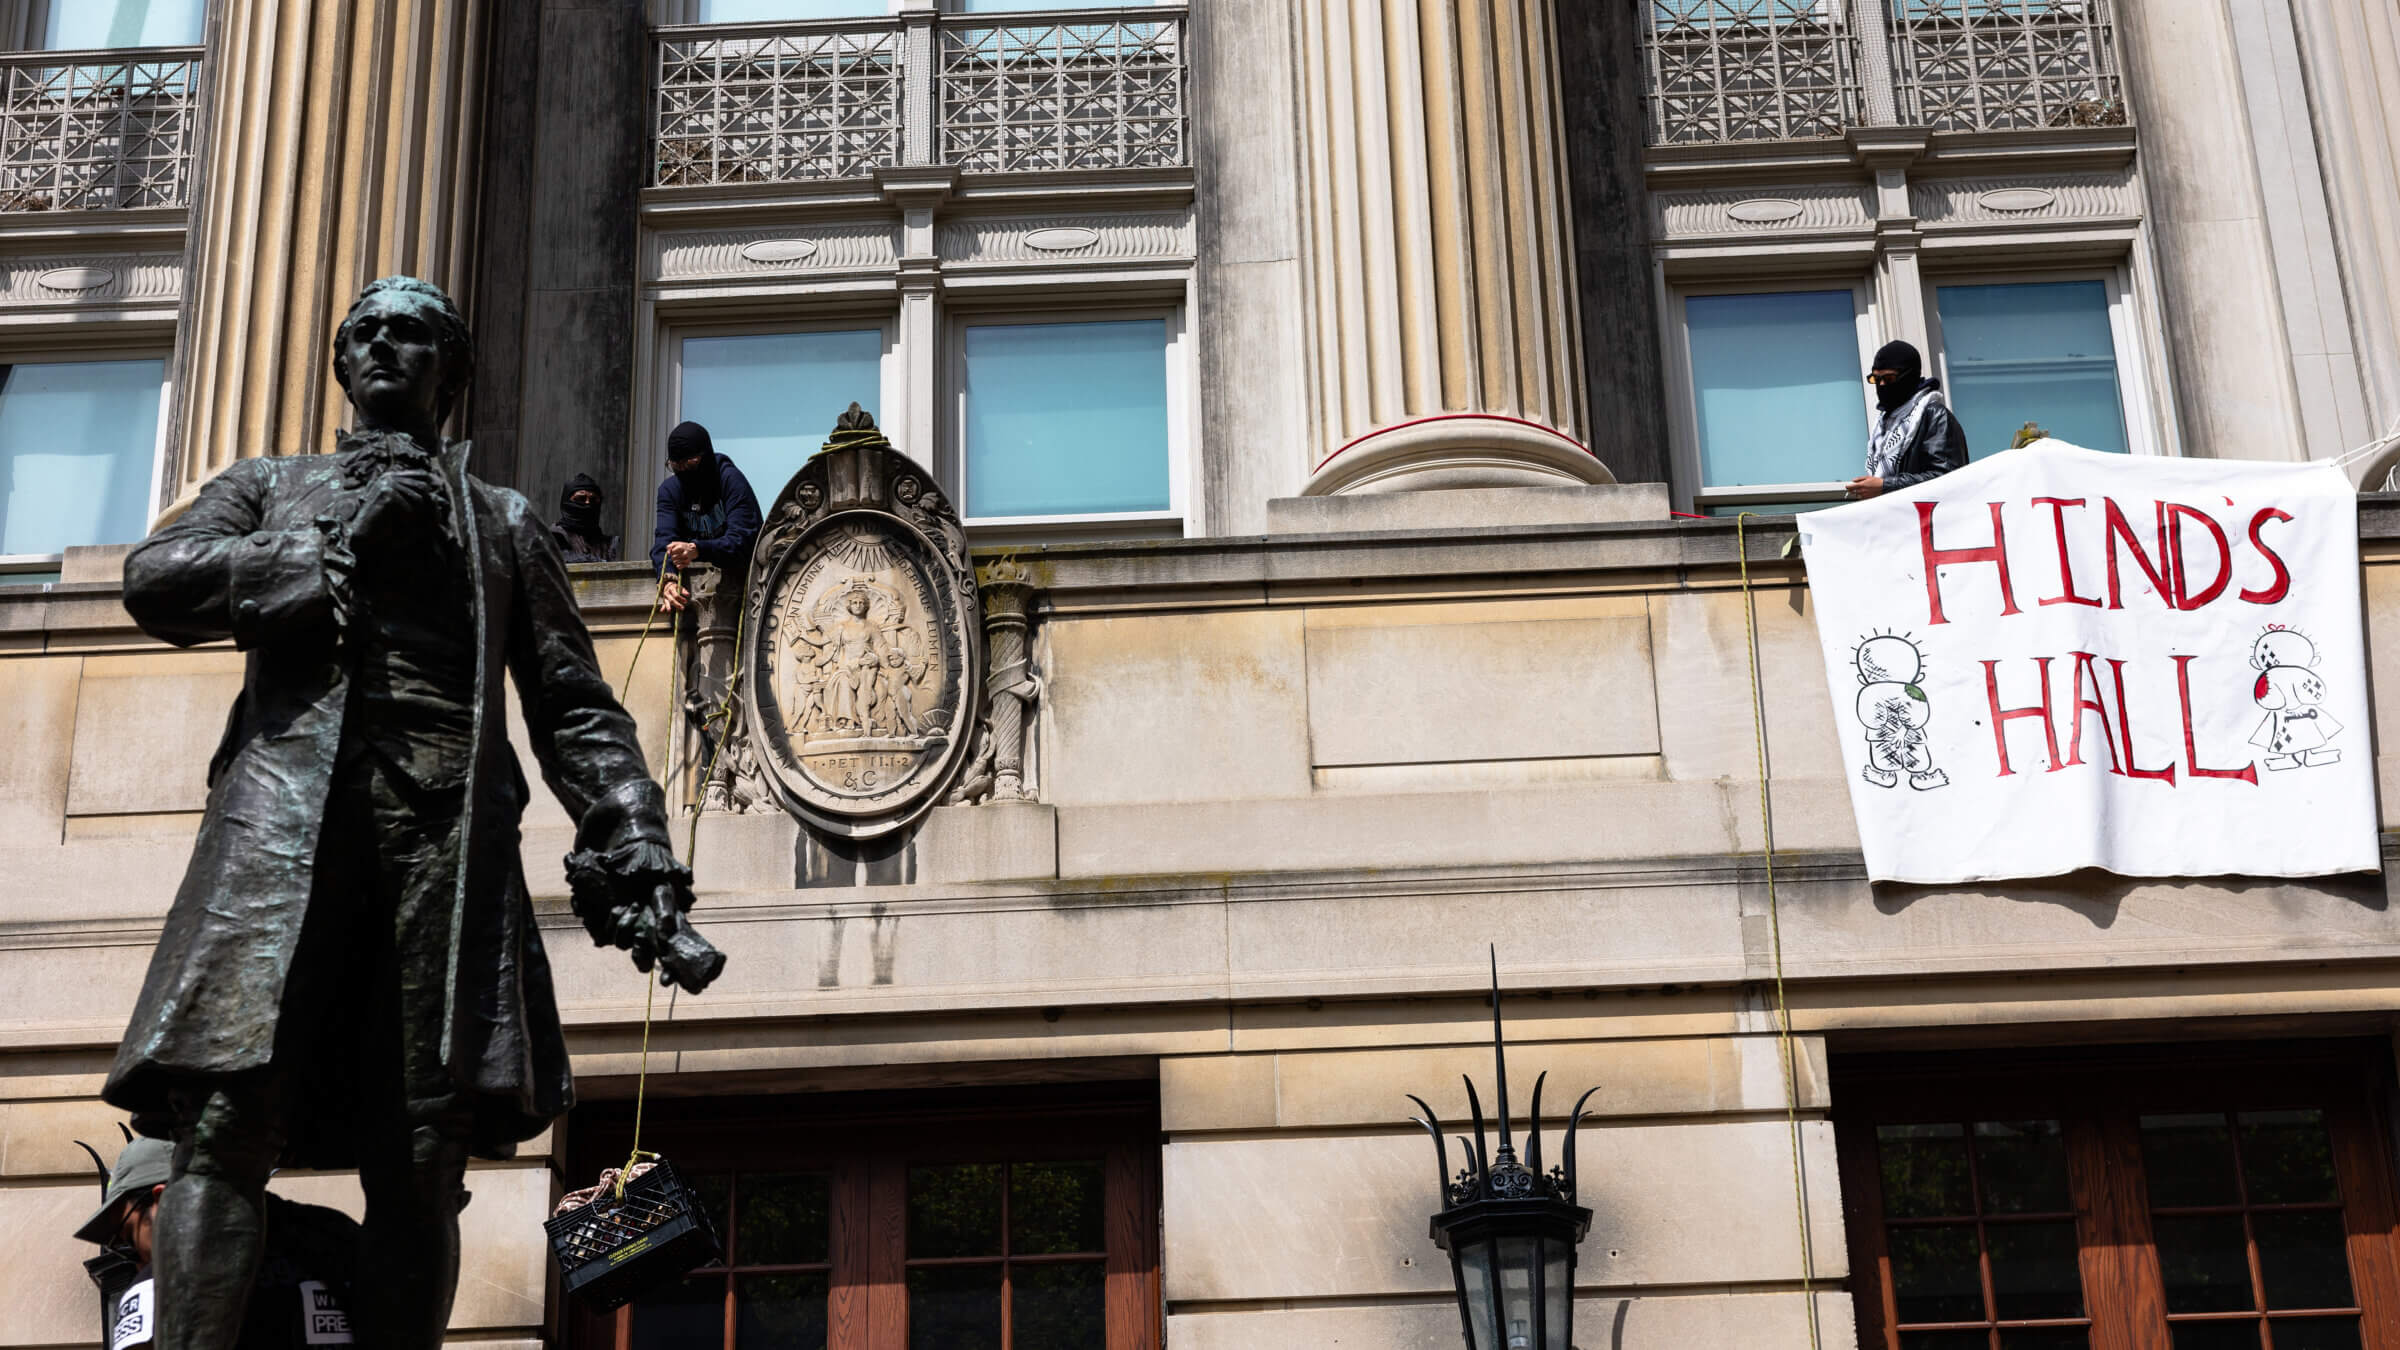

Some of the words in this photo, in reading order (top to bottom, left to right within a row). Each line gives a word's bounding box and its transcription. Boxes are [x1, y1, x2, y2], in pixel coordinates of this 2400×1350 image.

[795, 563, 826, 603] LUMINE
[1912, 495, 2294, 625] HIND'S
[926, 619, 940, 672] LUMEN
[1979, 650, 2259, 788] HALL
